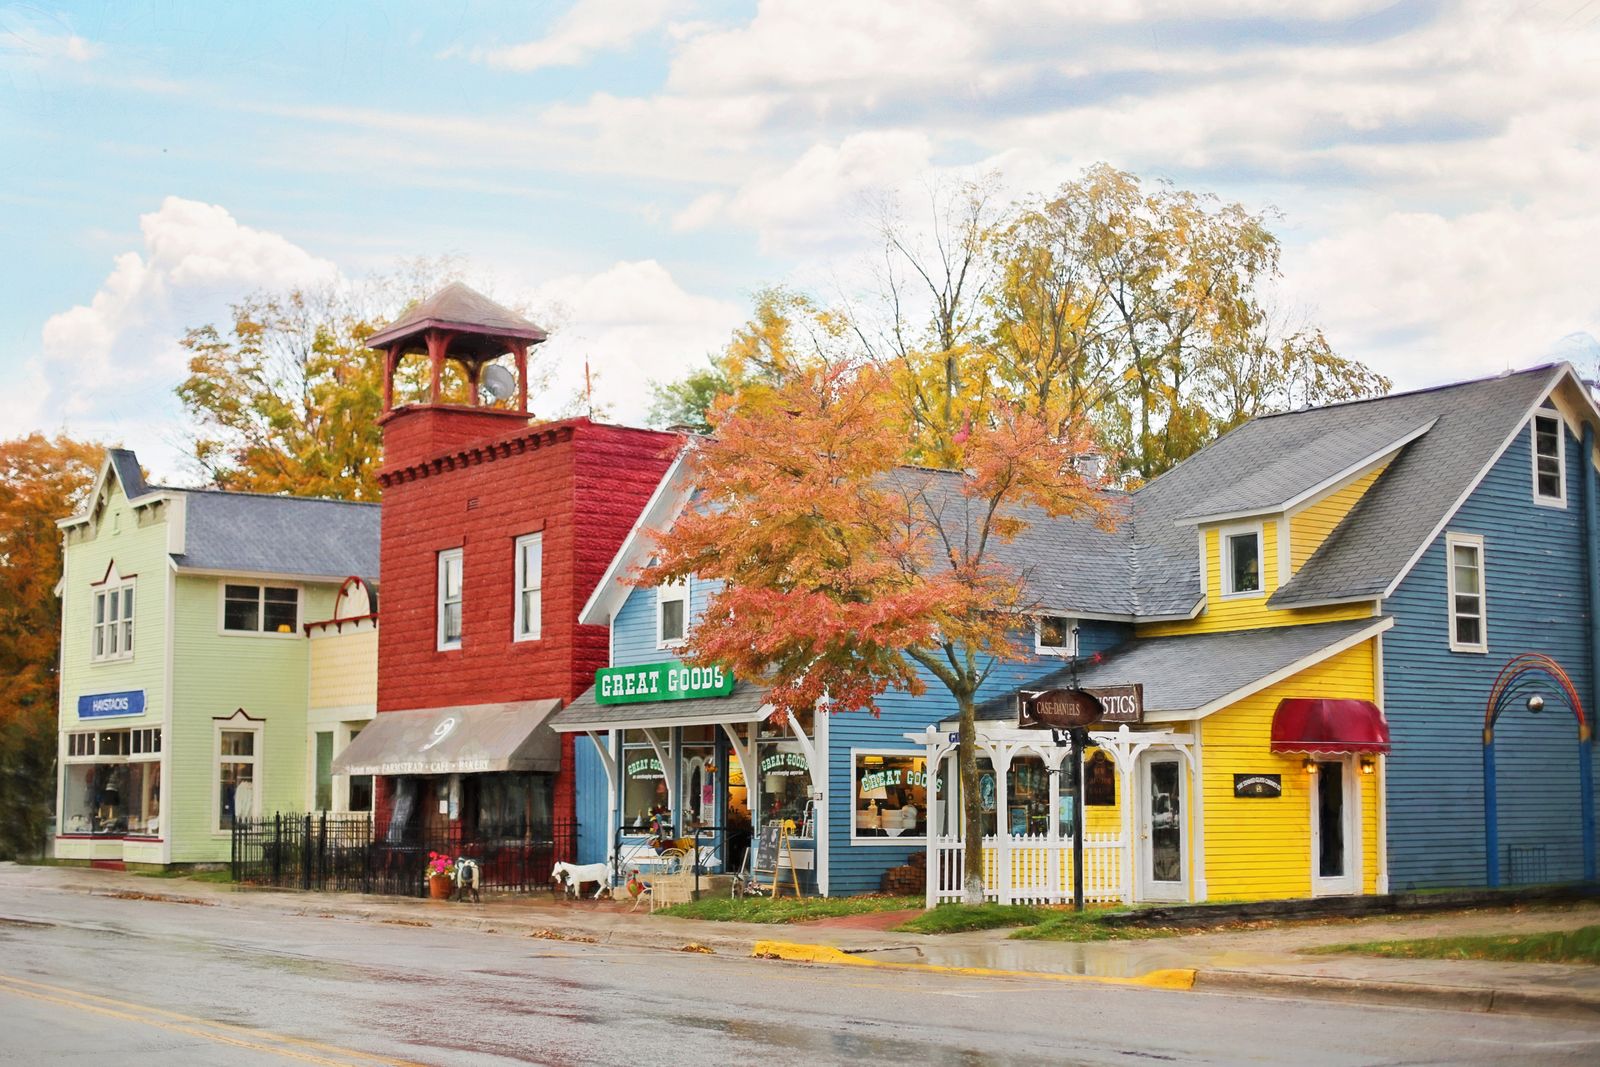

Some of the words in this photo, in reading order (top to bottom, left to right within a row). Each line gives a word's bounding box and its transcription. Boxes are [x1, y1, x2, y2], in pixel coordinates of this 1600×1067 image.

[602, 671, 660, 697] GREAT
[668, 666, 724, 692] GOODS
[92, 697, 129, 712] HAYSTACKS
[1036, 701, 1081, 716] CASE-DANIELS
[1096, 695, 1136, 715] STICS
[628, 758, 649, 776] GREAT
[650, 758, 664, 772] GOO
[761, 754, 785, 772] GREAT
[787, 753, 809, 771] GOODS
[861, 769, 902, 793] GREAT
[906, 769, 943, 793] GOOS
